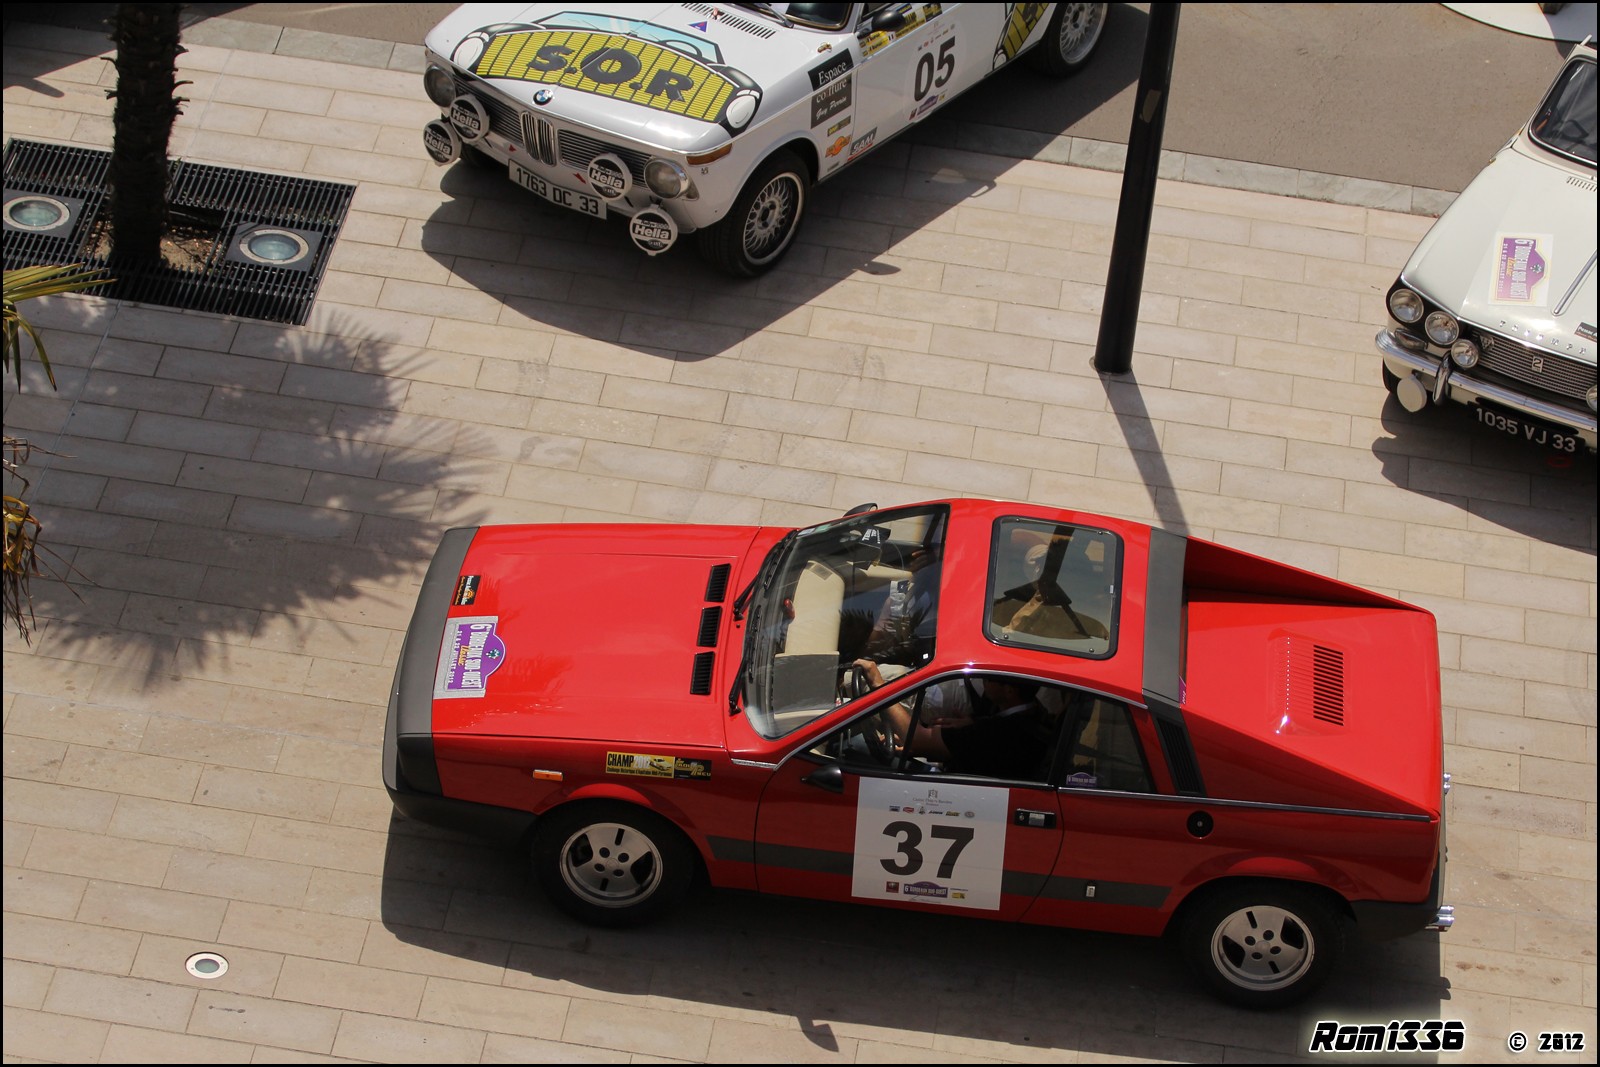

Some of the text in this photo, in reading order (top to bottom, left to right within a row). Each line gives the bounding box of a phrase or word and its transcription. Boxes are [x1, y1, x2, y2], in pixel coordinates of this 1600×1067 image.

[818, 61, 847, 84] Espace
[914, 36, 955, 102] 05
[452, 108, 480, 130] Hella
[425, 131, 452, 155] Hella
[851, 133, 875, 152] SAM
[516, 165, 547, 197] 1763
[578, 195, 599, 215] 33
[590, 168, 623, 189] Hella
[633, 223, 670, 240] Hella
[1532, 358, 1542, 368] 2
[1476, 408, 1576, 452] 1035 VJ 33
[466, 631, 490, 659] BORDEAUX
[461, 658, 482, 688] SUD-OUEST
[879, 821, 975, 880] 37
